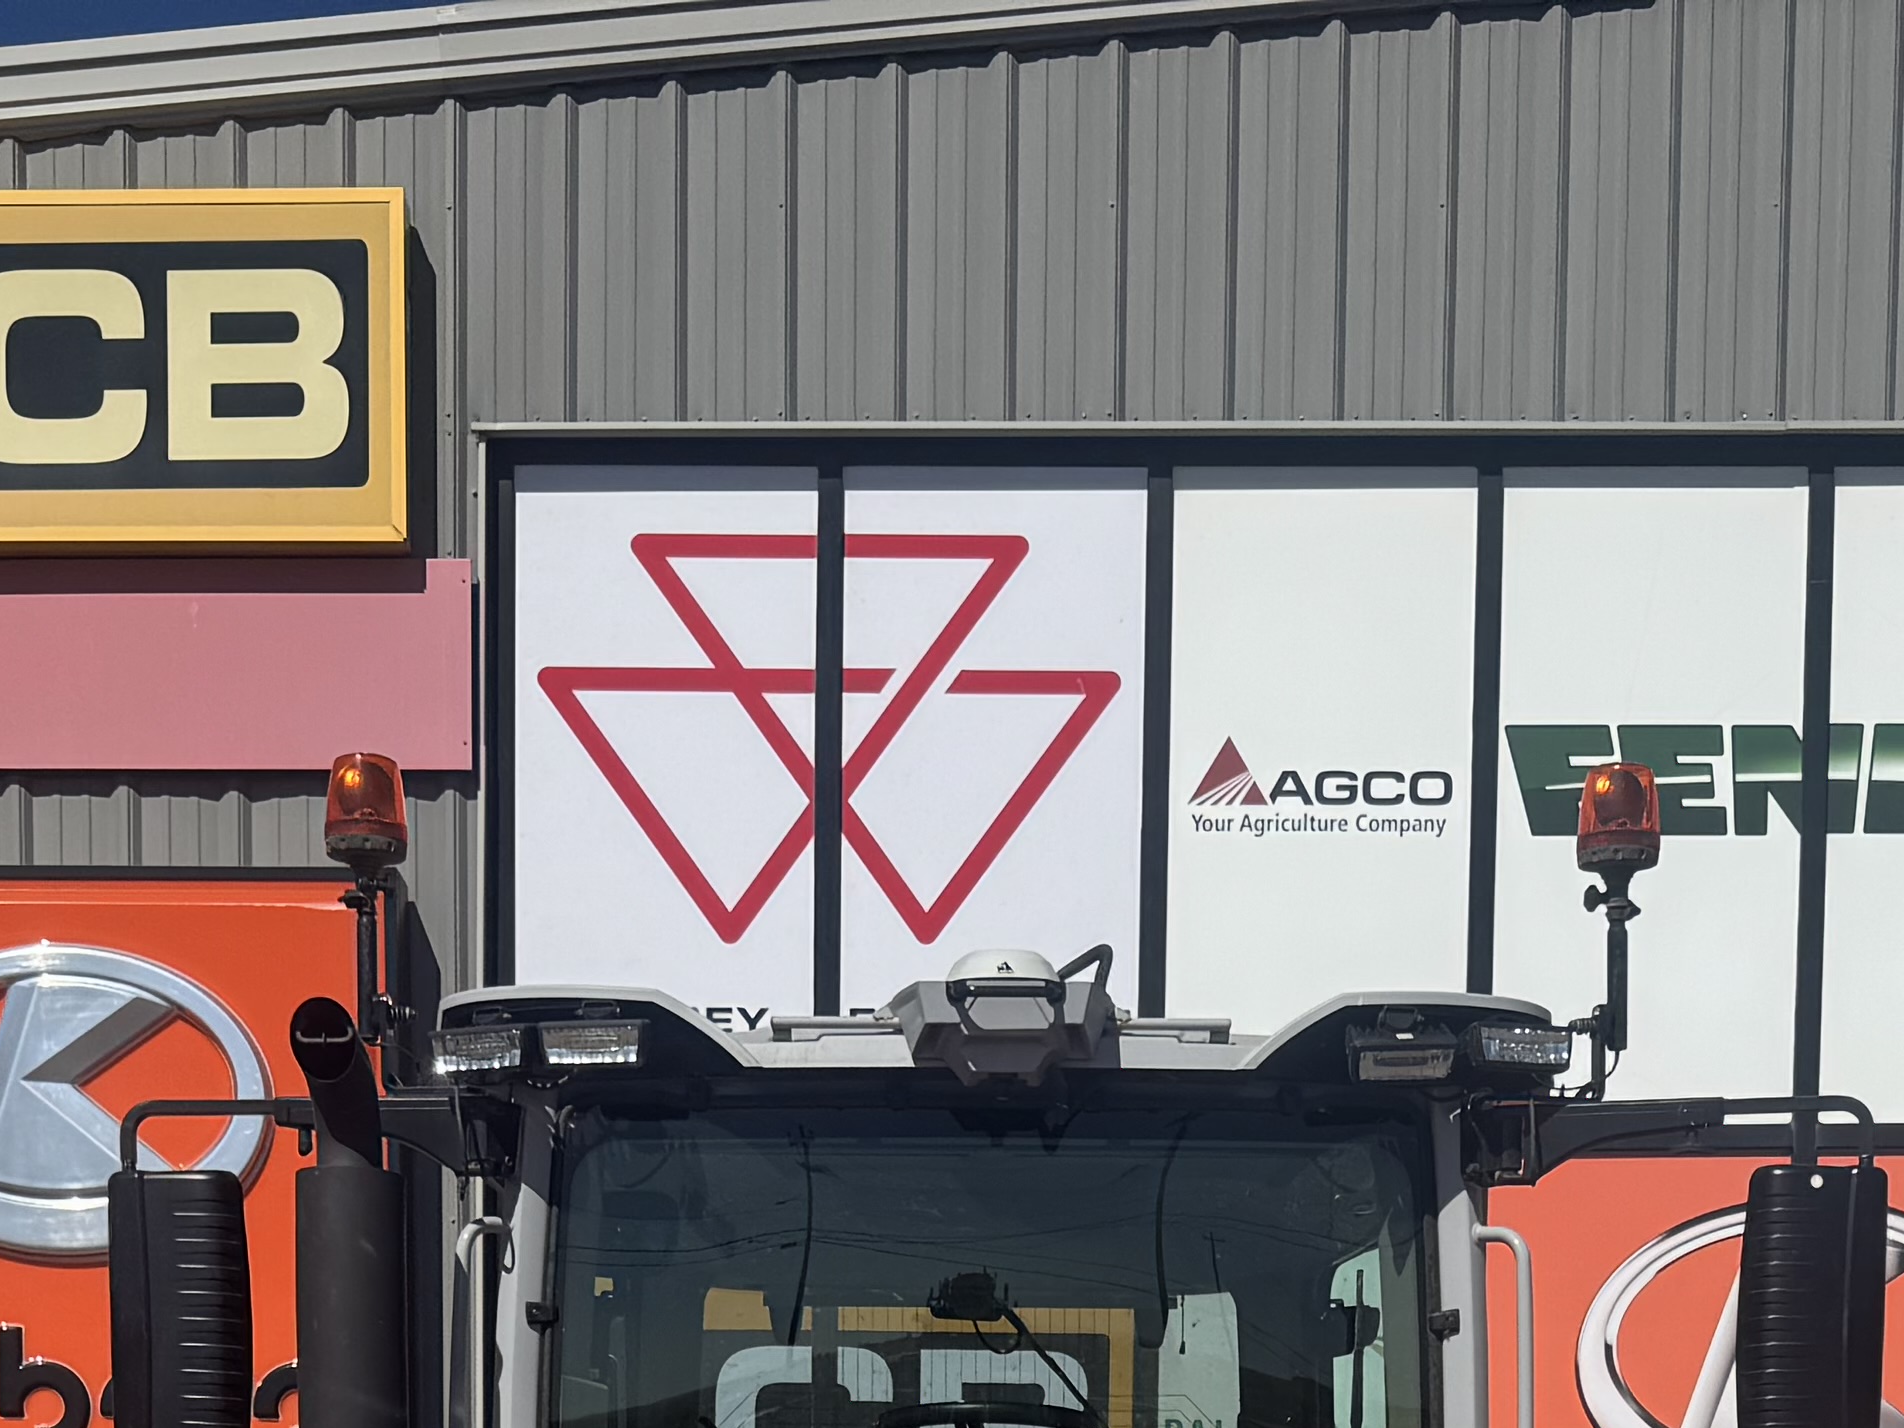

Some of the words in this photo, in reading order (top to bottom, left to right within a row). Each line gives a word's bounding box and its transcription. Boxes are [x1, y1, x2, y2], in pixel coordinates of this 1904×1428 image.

[1268, 770, 1454, 806] AGCO
[1191, 813, 1235, 833] Your
[1239, 813, 1349, 838] Agriculture
[1355, 813, 1447, 838] Company
